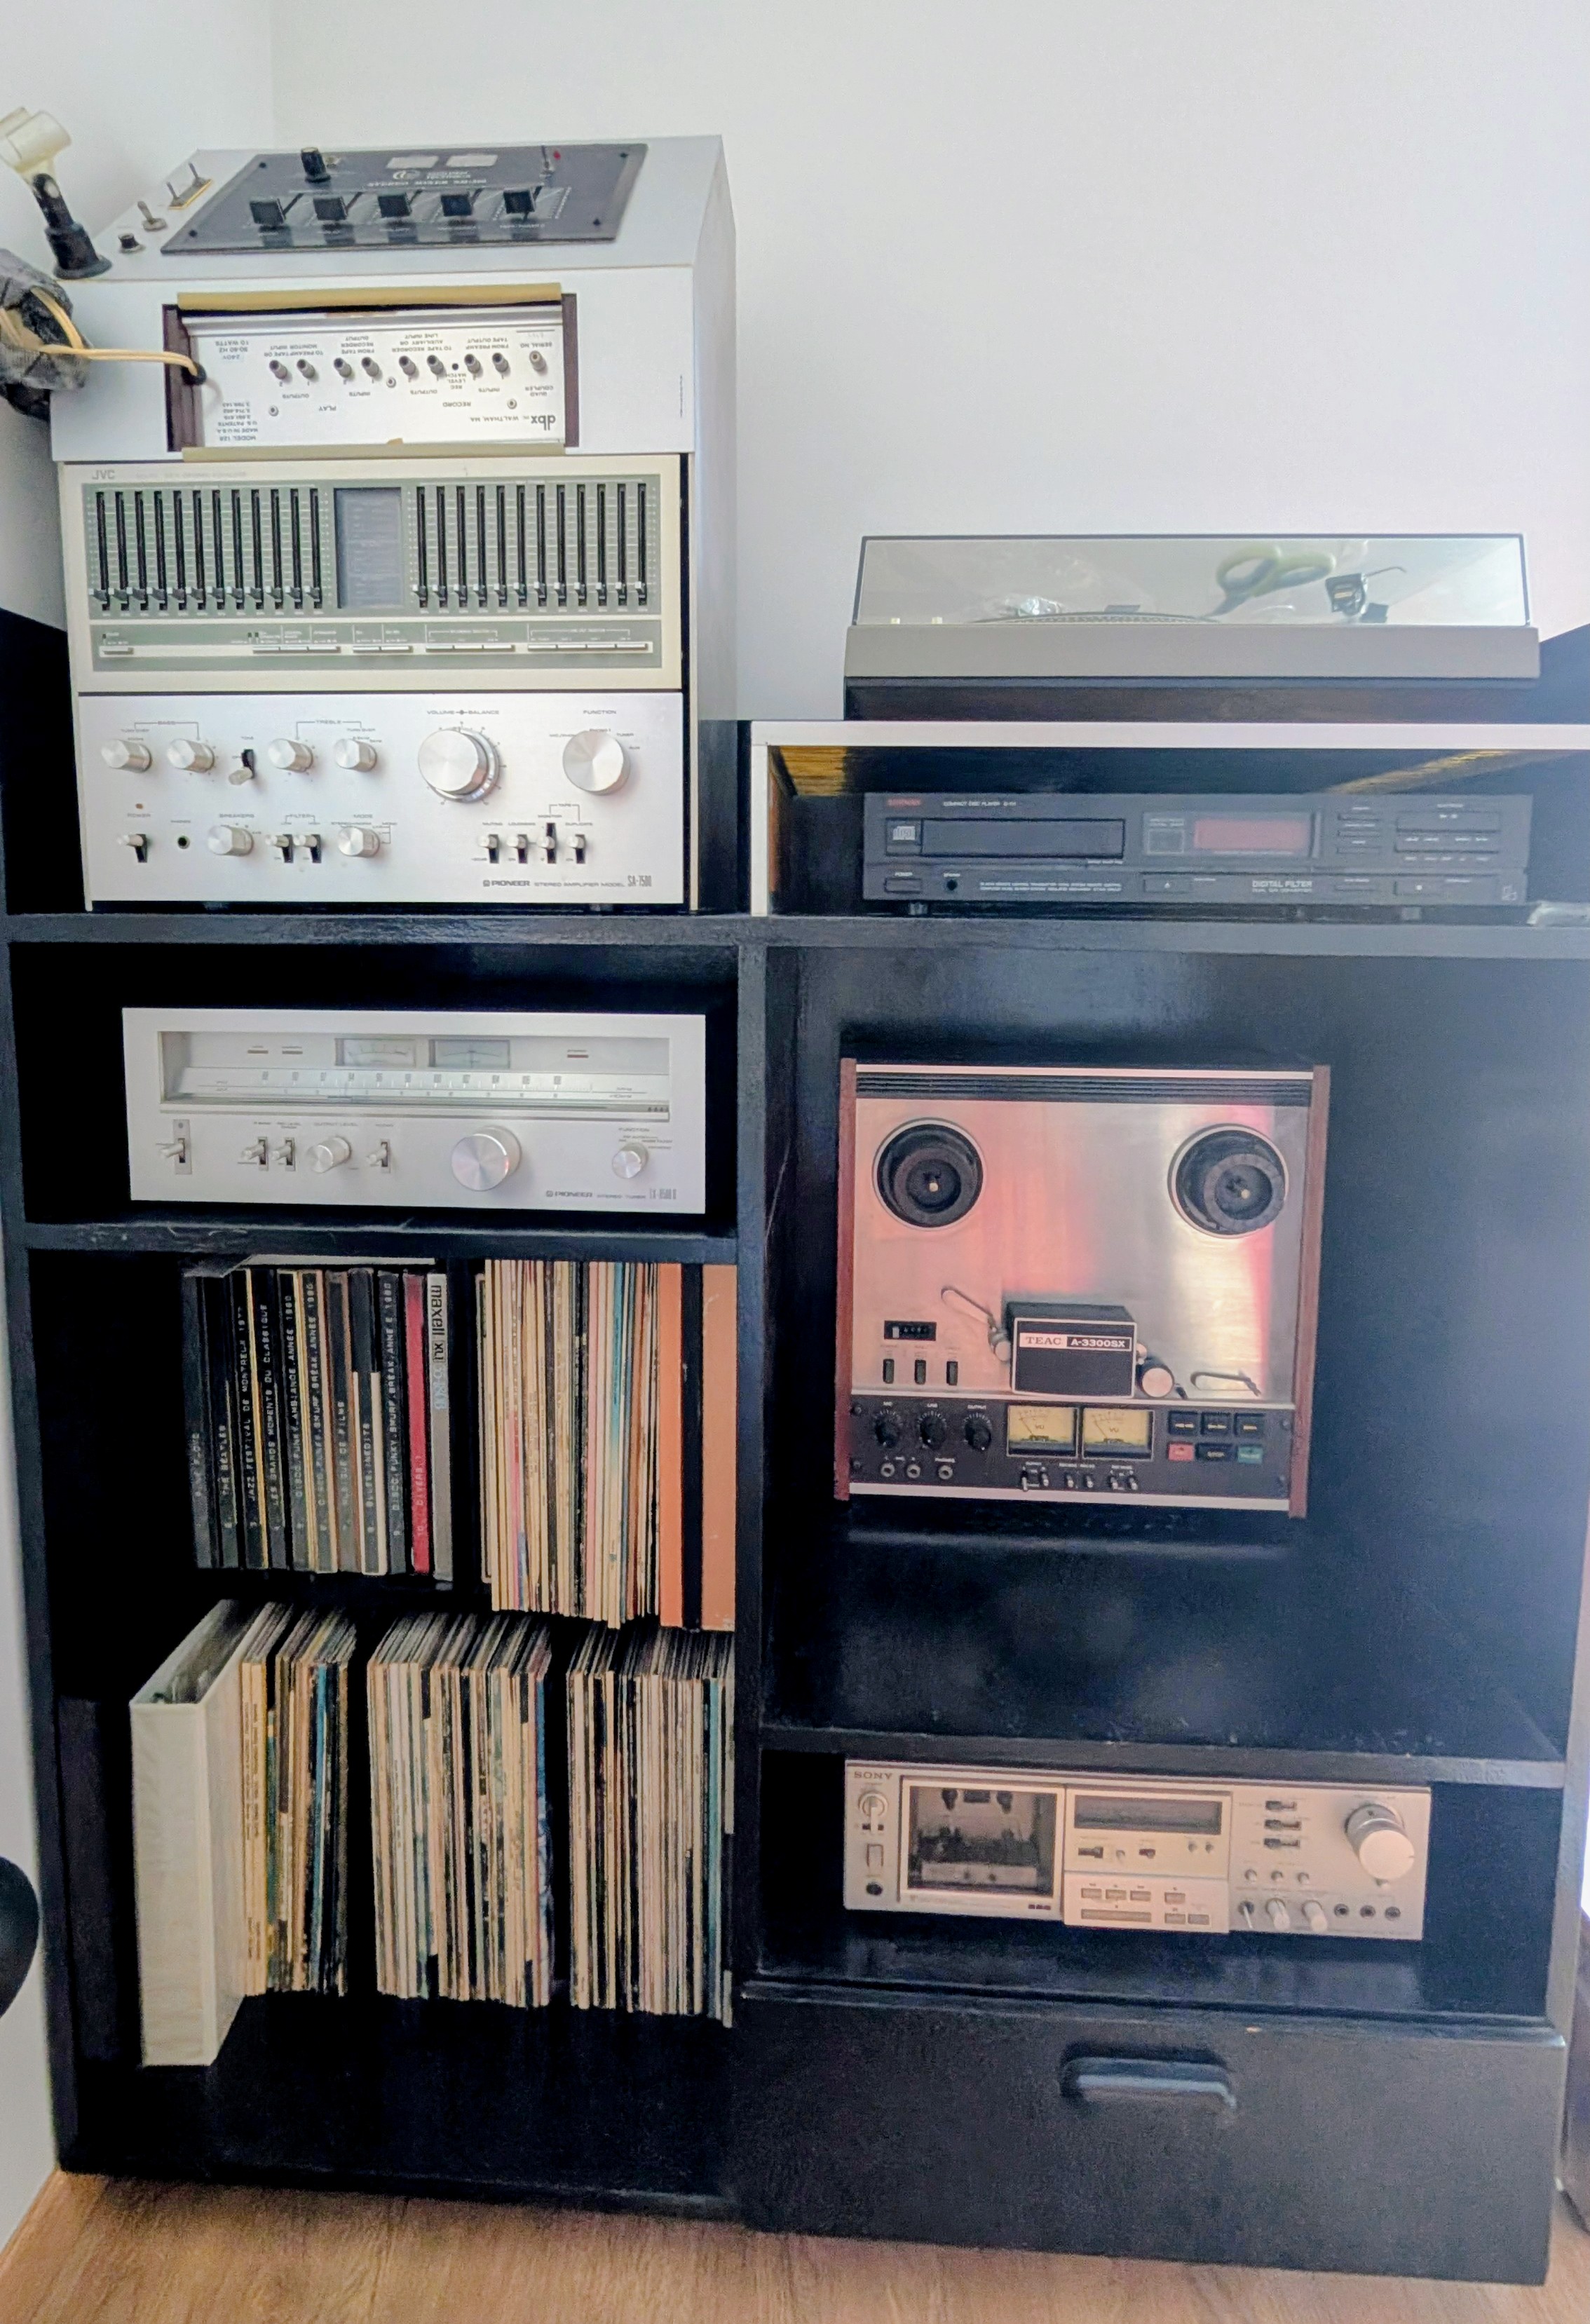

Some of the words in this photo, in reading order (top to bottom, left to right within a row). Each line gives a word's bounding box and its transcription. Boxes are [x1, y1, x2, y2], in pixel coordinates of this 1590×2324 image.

[531, 415, 556, 431] dbx
[91, 469, 115, 480] JVC
[430, 1284, 445, 1336] maxell
[1025, 1336, 1062, 1346] TEAC
[1070, 1339, 1126, 1348] A-3300SX
[246, 1476, 256, 1502] JAZZ
[853, 1771, 893, 1779] SONY
